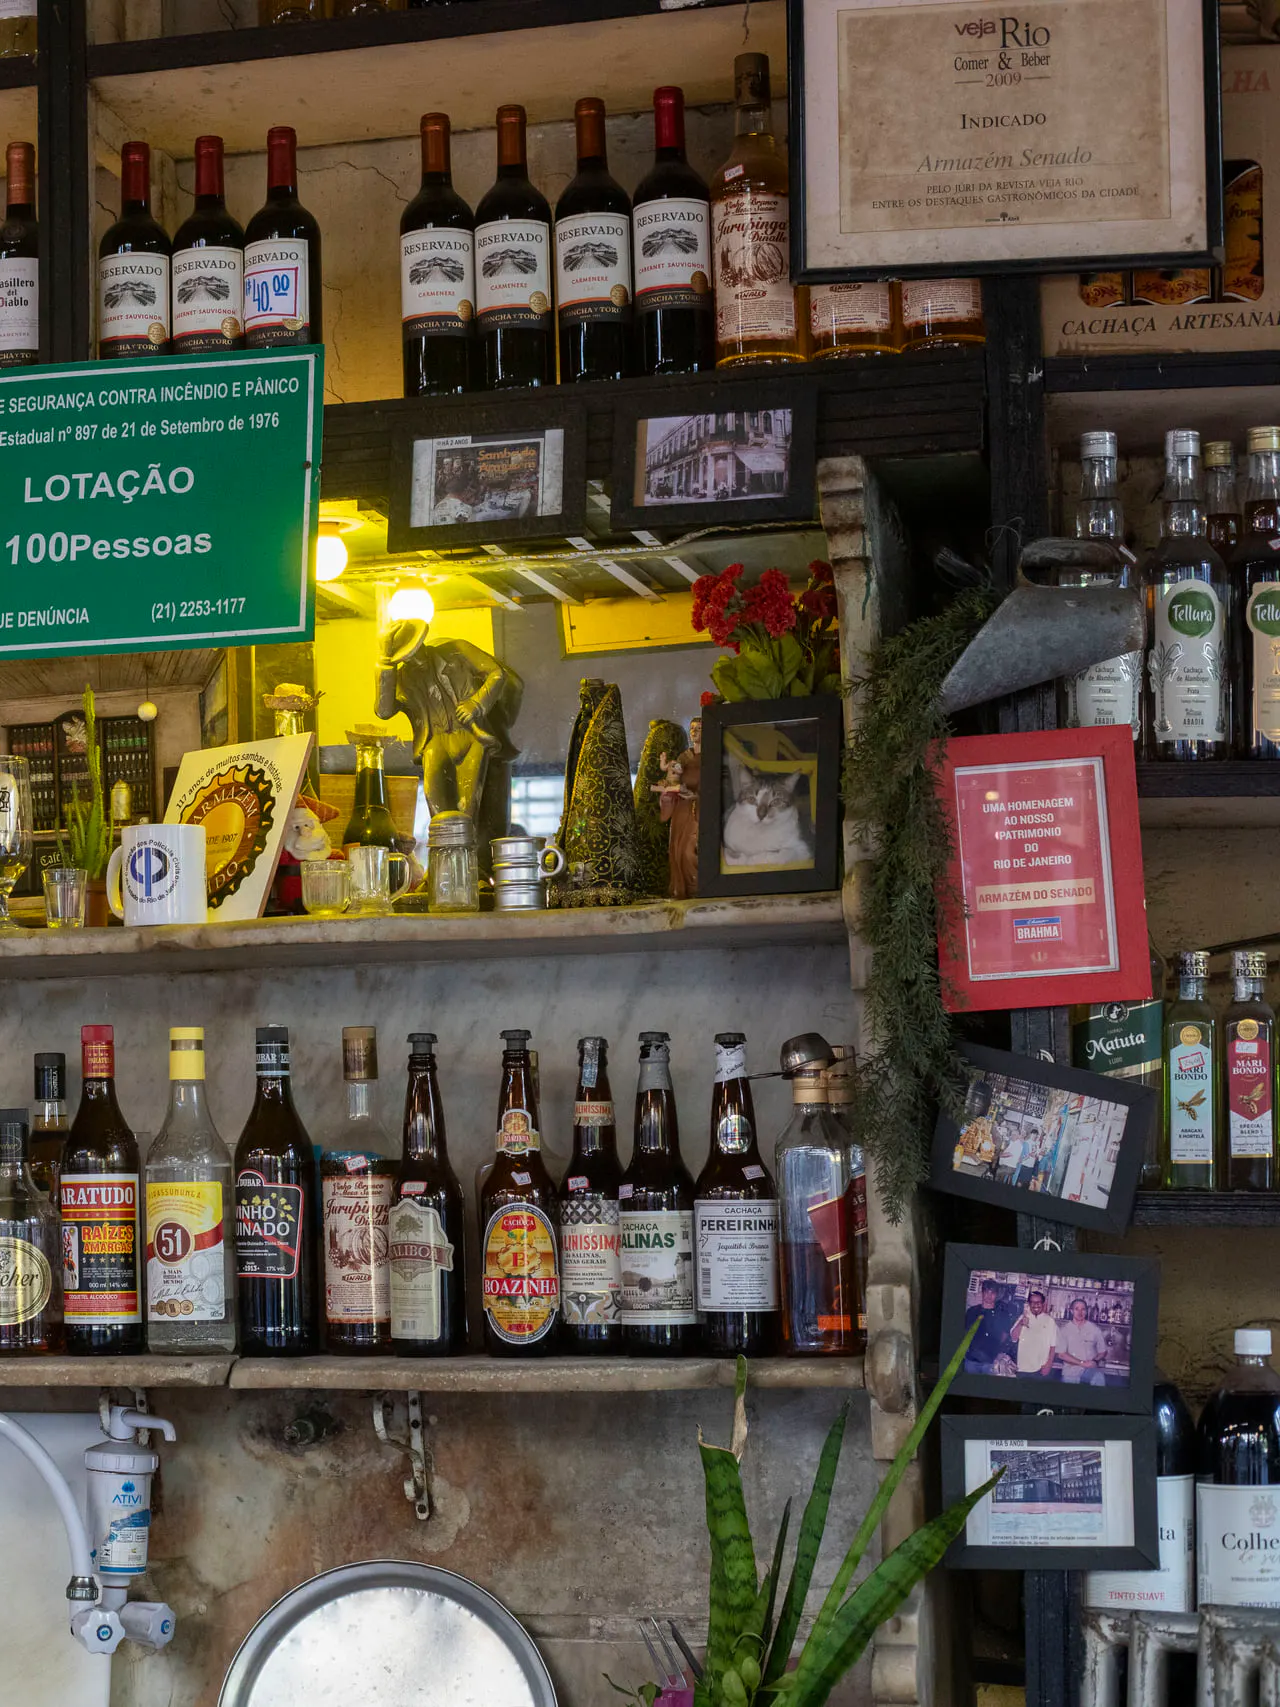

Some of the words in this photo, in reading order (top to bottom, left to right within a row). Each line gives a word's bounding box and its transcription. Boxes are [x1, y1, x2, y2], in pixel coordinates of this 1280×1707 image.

[954, 19, 996, 39] veja
[1000, 18, 1051, 48] Rio
[954, 57, 989, 71] Comer
[998, 52, 1012, 70] &
[1021, 53, 1051, 67] Beber
[985, 73, 1021, 87] 2009
[916, 152, 1013, 173] Armazém
[1020, 146, 1092, 167] Senado
[927, 185, 951, 194] PELO
[954, 181, 975, 194] JÚRI
[979, 182, 993, 191] DA
[996, 180, 1034, 190] REVISTA
[1039, 179, 1061, 189] VEJA
[1065, 178, 1083, 186] RIO
[872, 199, 904, 210] ENTRE
[908, 198, 921, 207] OS
[926, 195, 984, 207] DESTAQUES
[987, 190, 1077, 203] GASTRONÔMICOS
[1082, 190, 1095, 198] DA
[1100, 187, 1139, 197] CIDADE
[637, 212, 704, 228] RESERVADO
[1062, 317, 1156, 336] CACHAÇA
[9, 393, 95, 415] SEGURANÇA
[99, 388, 156, 407] CONTRA
[161, 382, 228, 403] INCÊNDIO
[232, 382, 241, 398] E
[245, 376, 299, 397] PÂNICO
[0, 426, 54, 446] Estadual
[76, 425, 97, 440] 897
[102, 422, 117, 438] de
[121, 422, 135, 437] 21
[141, 420, 156, 436] de
[161, 413, 223, 435] Setembro
[229, 413, 243, 430] de
[249, 412, 279, 428] 1976
[24, 463, 195, 503] LOTAÇÃO
[6, 531, 212, 565] 100Pessoas
[18, 607, 89, 627] DENÚNCIA
[152, 602, 175, 623] (21)
[180, 598, 245, 617] 2253-1177
[1172, 604, 1212, 623] Tellura
[194, 786, 258, 825] ARMAZÉM
[983, 802, 1006, 812] UMA
[1008, 798, 1073, 810] HOMENAGEM
[1005, 816, 1017, 825] AO
[1020, 813, 1054, 824] NOSSO
[1000, 827, 1061, 840] PATRIMONIO
[1025, 843, 1038, 852] DO
[994, 860, 1010, 869] RIO
[1013, 858, 1026, 867] DE
[1028, 855, 1072, 867] JANEIRO
[978, 889, 1031, 904] ARMAZÉM
[1034, 890, 1047, 899] DO
[1050, 887, 1092, 898] SENADO
[1018, 926, 1059, 939] BRAHMA
[1086, 1032, 1145, 1061] Matuta
[1232, 1065, 1266, 1075] BONDO
[81, 1222, 134, 1242] RAÍZES
[83, 1241, 133, 1254] AMARGAS
[161, 1229, 182, 1256] 51
[484, 1279, 557, 1295] BOAZINHA
[112, 1494, 142, 1504] ATIVI
[1108, 1591, 1136, 1600] TINTO
[1138, 1592, 1165, 1600] SUAVE
